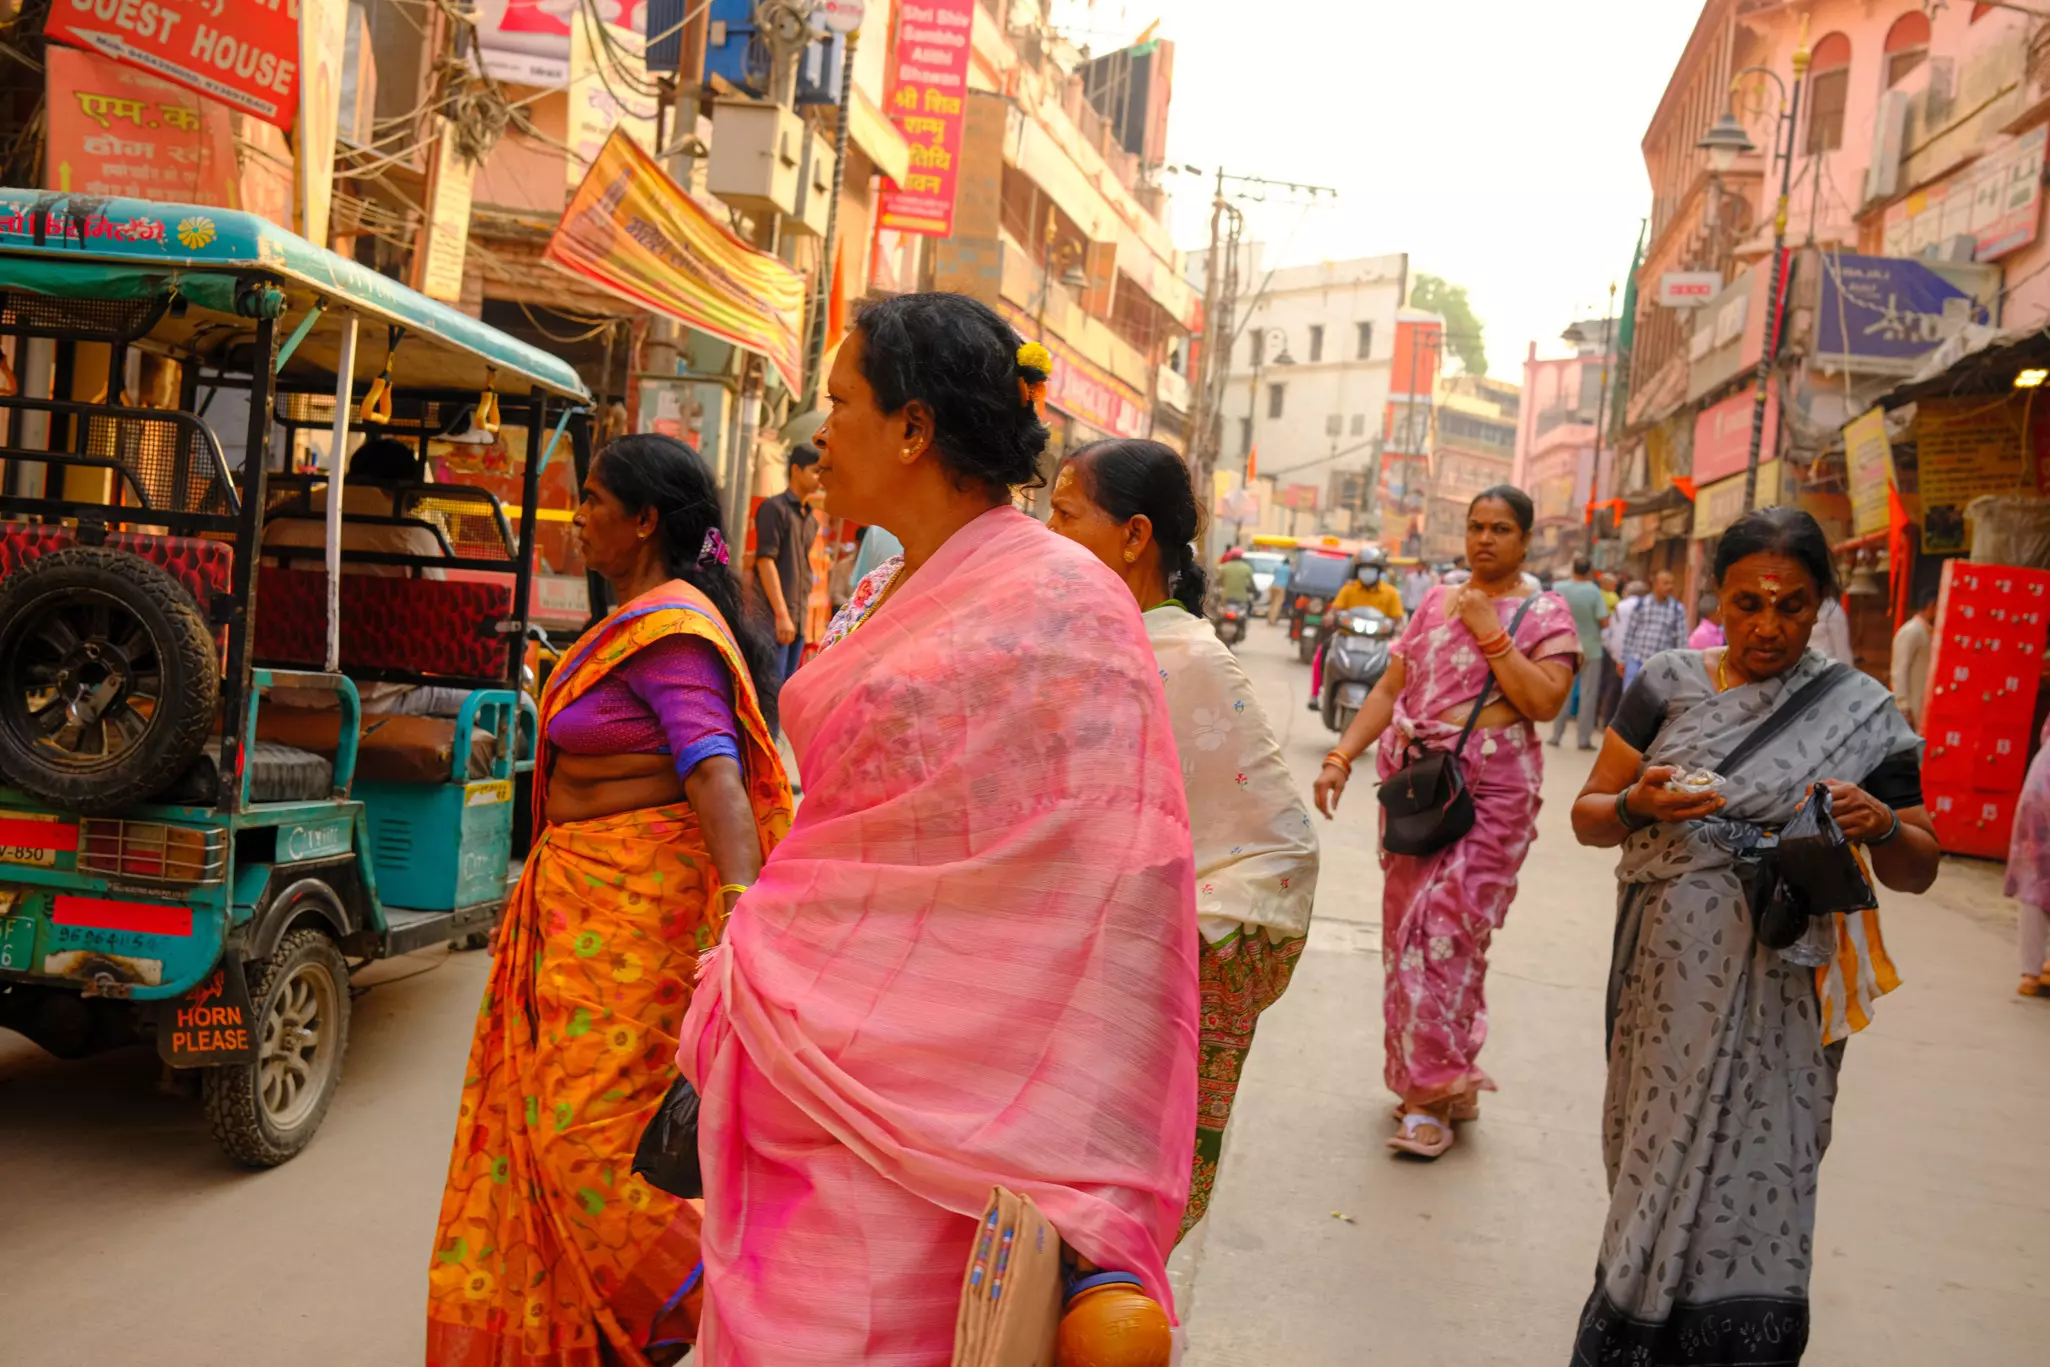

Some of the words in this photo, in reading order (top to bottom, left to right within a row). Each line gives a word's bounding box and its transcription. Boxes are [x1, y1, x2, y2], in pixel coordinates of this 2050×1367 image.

[190, 24, 297, 96] HOUSE
[176, 1007, 242, 1028] HORN
[172, 1030, 249, 1053] PLEASE
